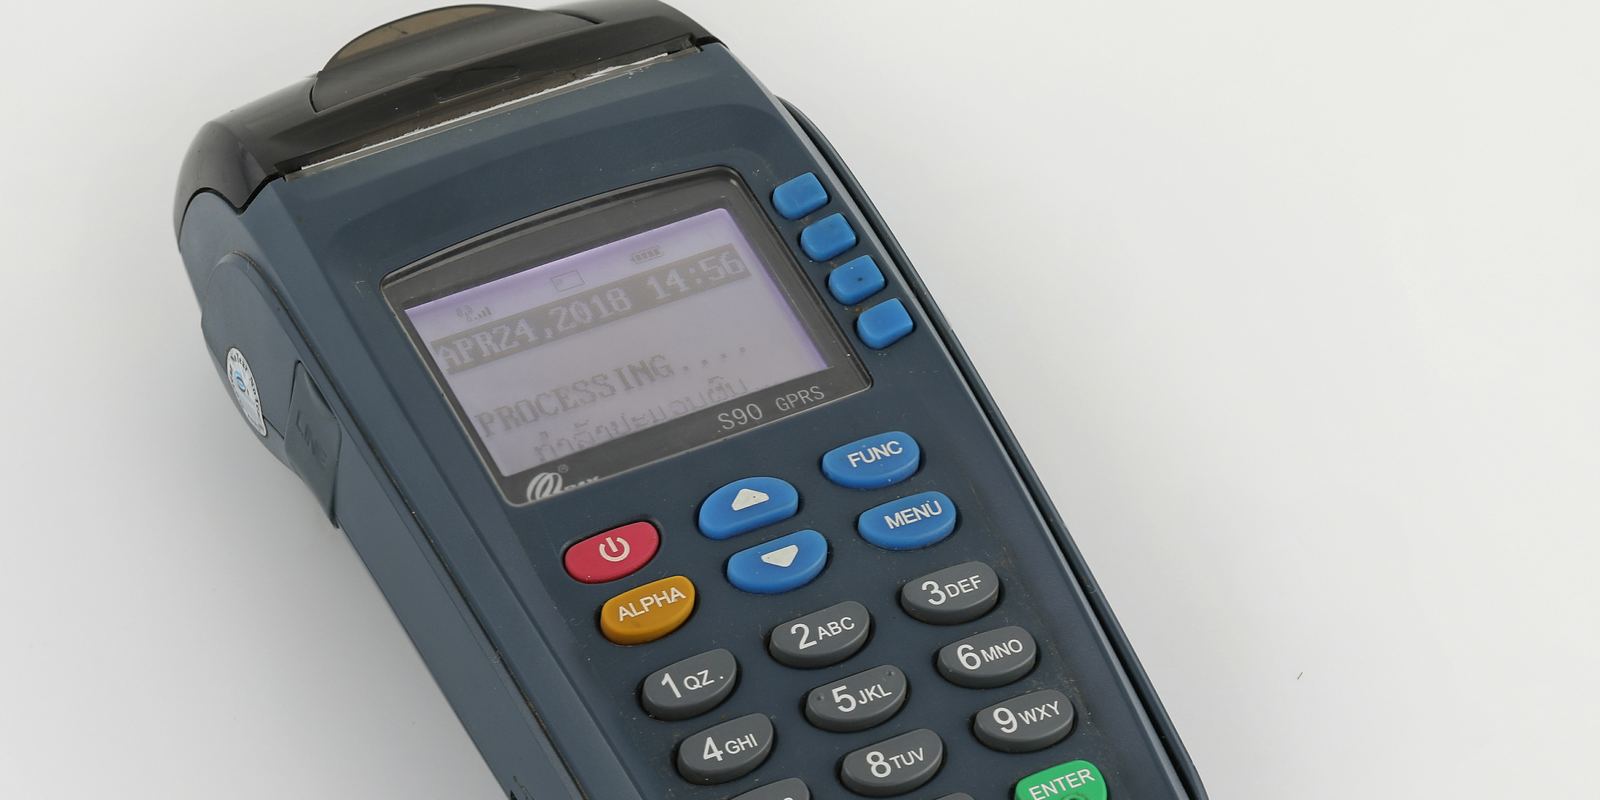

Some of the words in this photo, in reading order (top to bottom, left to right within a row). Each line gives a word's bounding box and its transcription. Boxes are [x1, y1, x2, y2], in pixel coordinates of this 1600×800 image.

[647, 252, 745, 300] 14:56
[718, 402, 763, 430] S90
[775, 385, 825, 412] GPRS
[847, 440, 903, 468] FUNC
[884, 501, 943, 529] MENU
[944, 574, 983, 598] DEF
[617, 588, 686, 622] ALPHA
[816, 616, 855, 641] ABC
[980, 638, 1023, 664] MNO
[858, 684, 892, 706] JKL
[1017, 700, 1060, 725] WXY
[725, 733, 758, 756] GHI
[889, 747, 925, 768] TUV
[1028, 768, 1096, 800] ENTER
